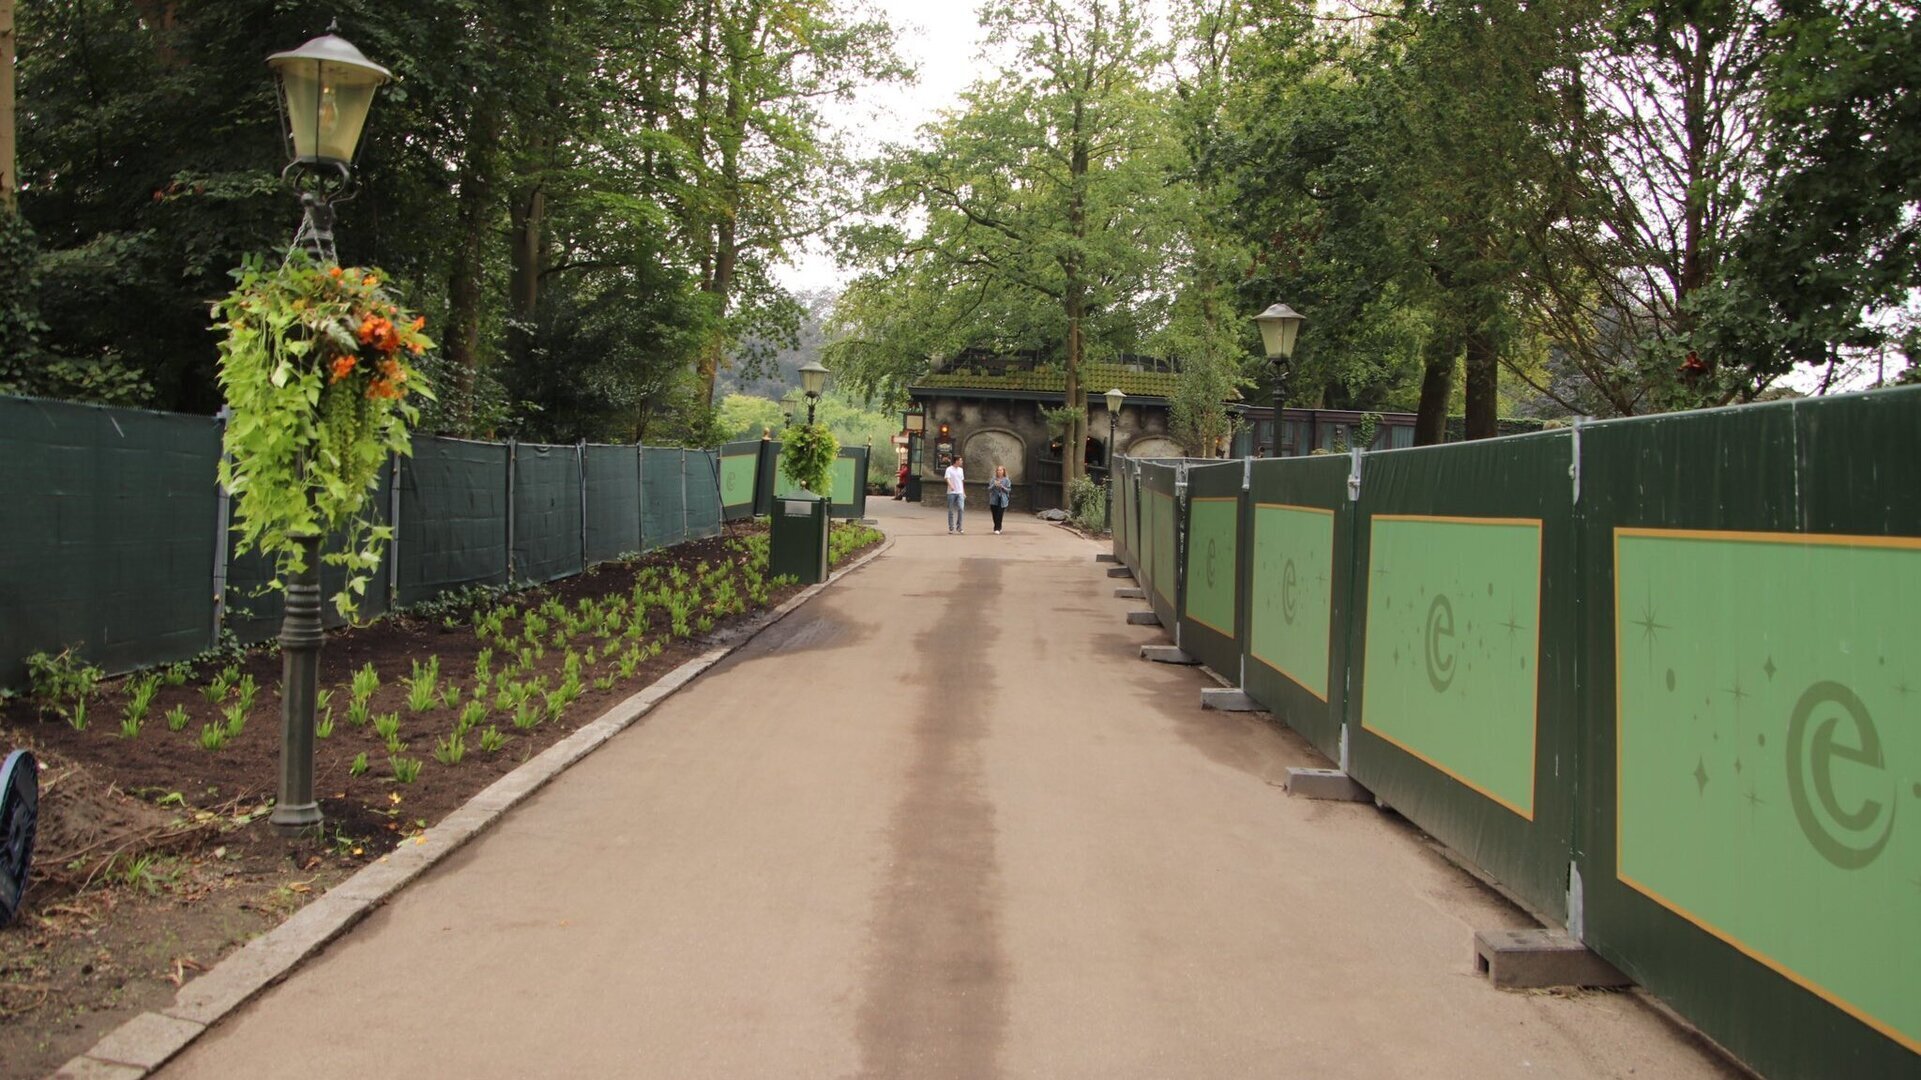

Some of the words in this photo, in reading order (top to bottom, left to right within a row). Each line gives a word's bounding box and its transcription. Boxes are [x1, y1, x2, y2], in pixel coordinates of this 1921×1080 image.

[1283, 559, 1296, 626] e
[1425, 594, 1458, 693] e
[1786, 680, 1898, 871] e
